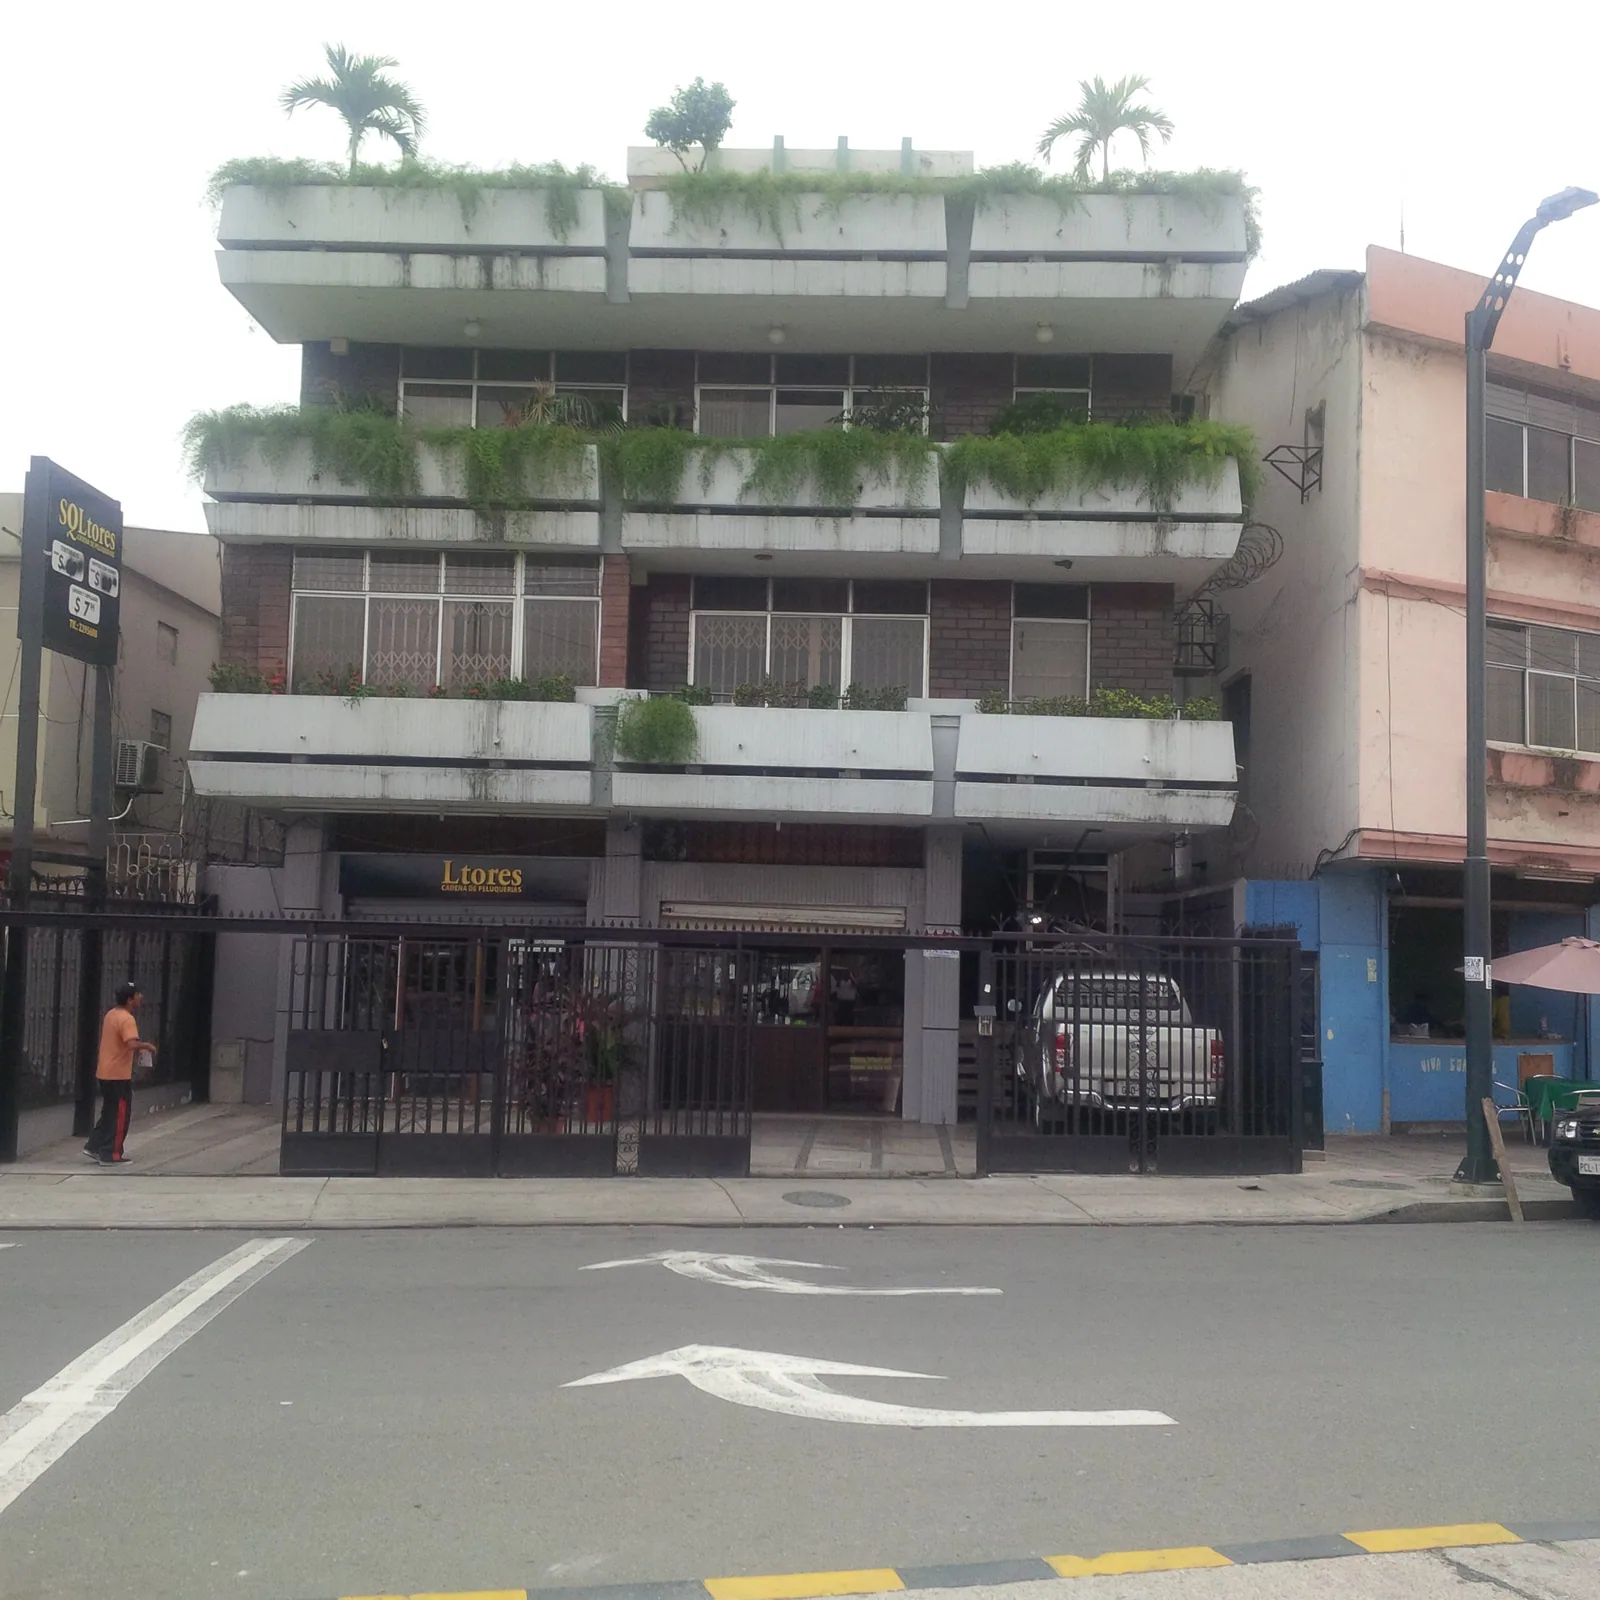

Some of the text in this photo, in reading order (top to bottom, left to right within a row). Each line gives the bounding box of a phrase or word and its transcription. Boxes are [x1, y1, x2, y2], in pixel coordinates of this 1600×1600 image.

[58, 498, 116, 550] SQLtores
[74, 597, 81, 614] $
[442, 860, 522, 886] Ltores
[479, 885, 522, 893] PELUQUERIAS
